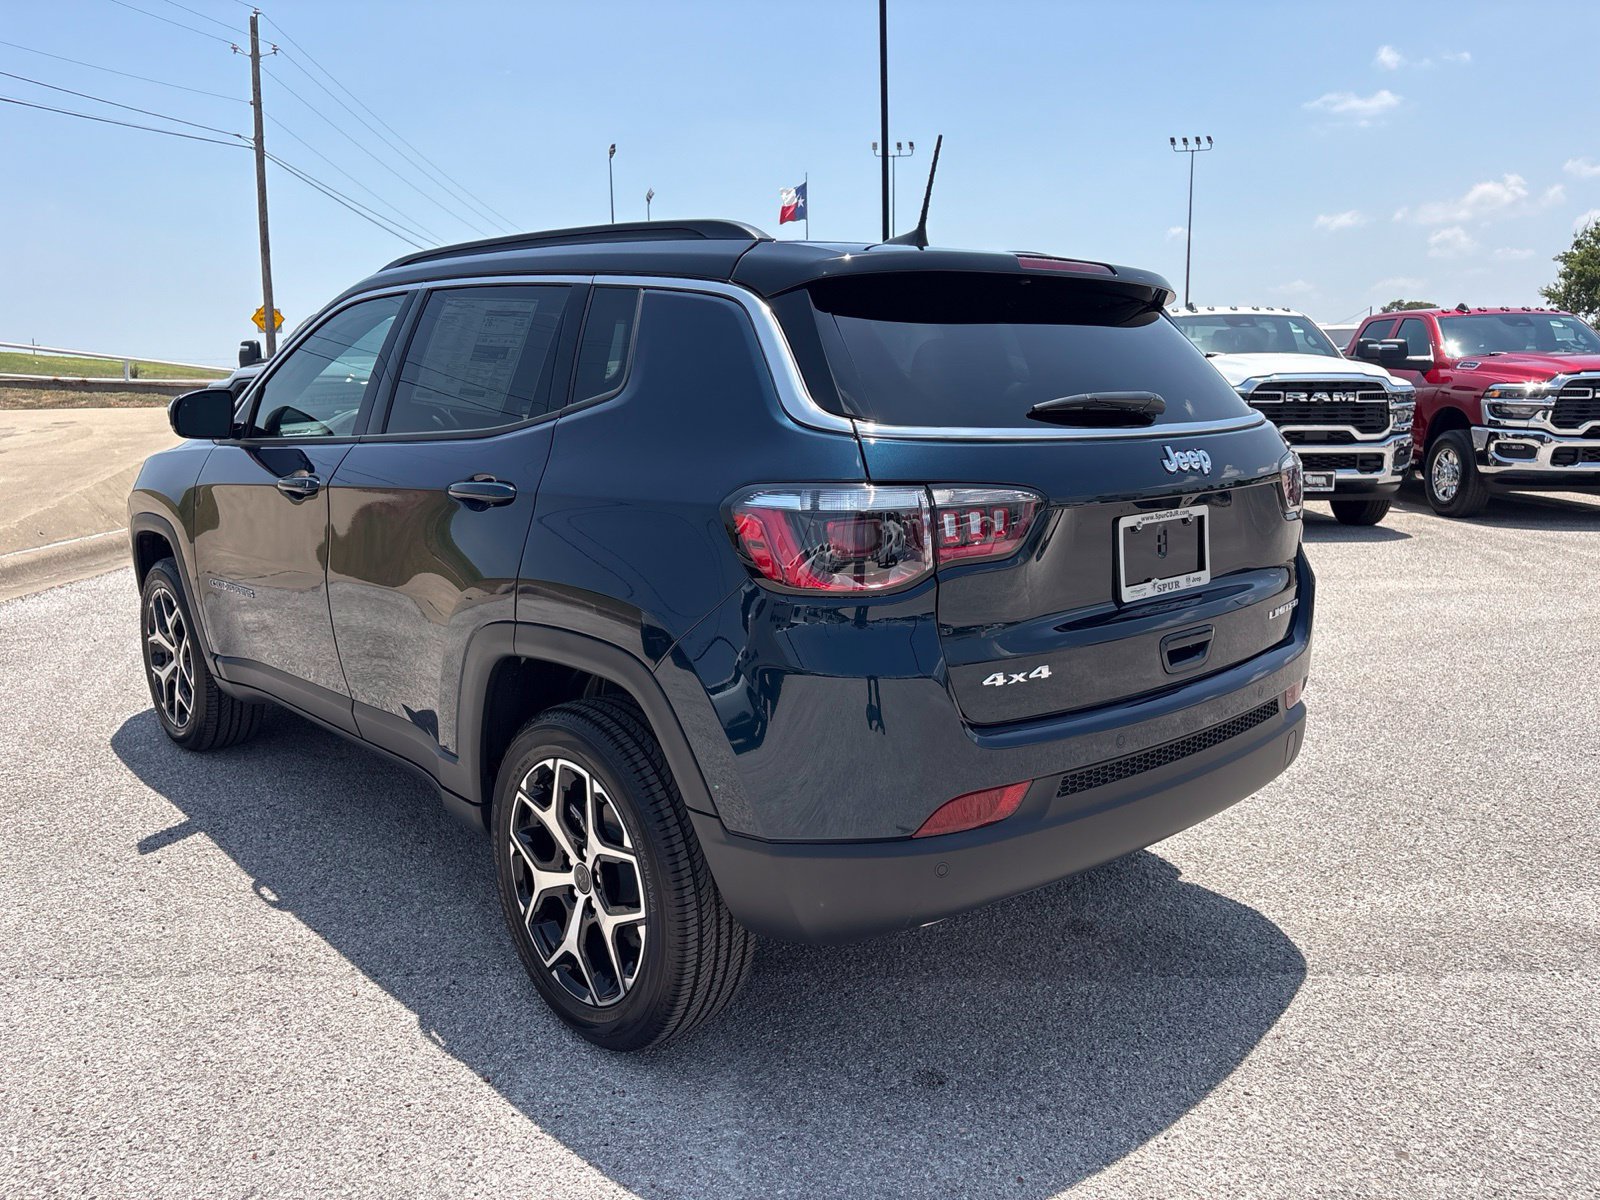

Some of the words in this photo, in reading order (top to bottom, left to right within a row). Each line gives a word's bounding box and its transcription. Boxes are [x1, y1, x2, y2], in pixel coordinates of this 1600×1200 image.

[1285, 392, 1356, 402] RAM
[1161, 445, 1211, 475] Jeep
[1141, 509, 1190, 522] www.SpurCDJR.com
[1157, 580, 1181, 593] SPUR
[982, 664, 1053, 687] 4x4
[634, 832, 657, 914] YOKOHAMA
